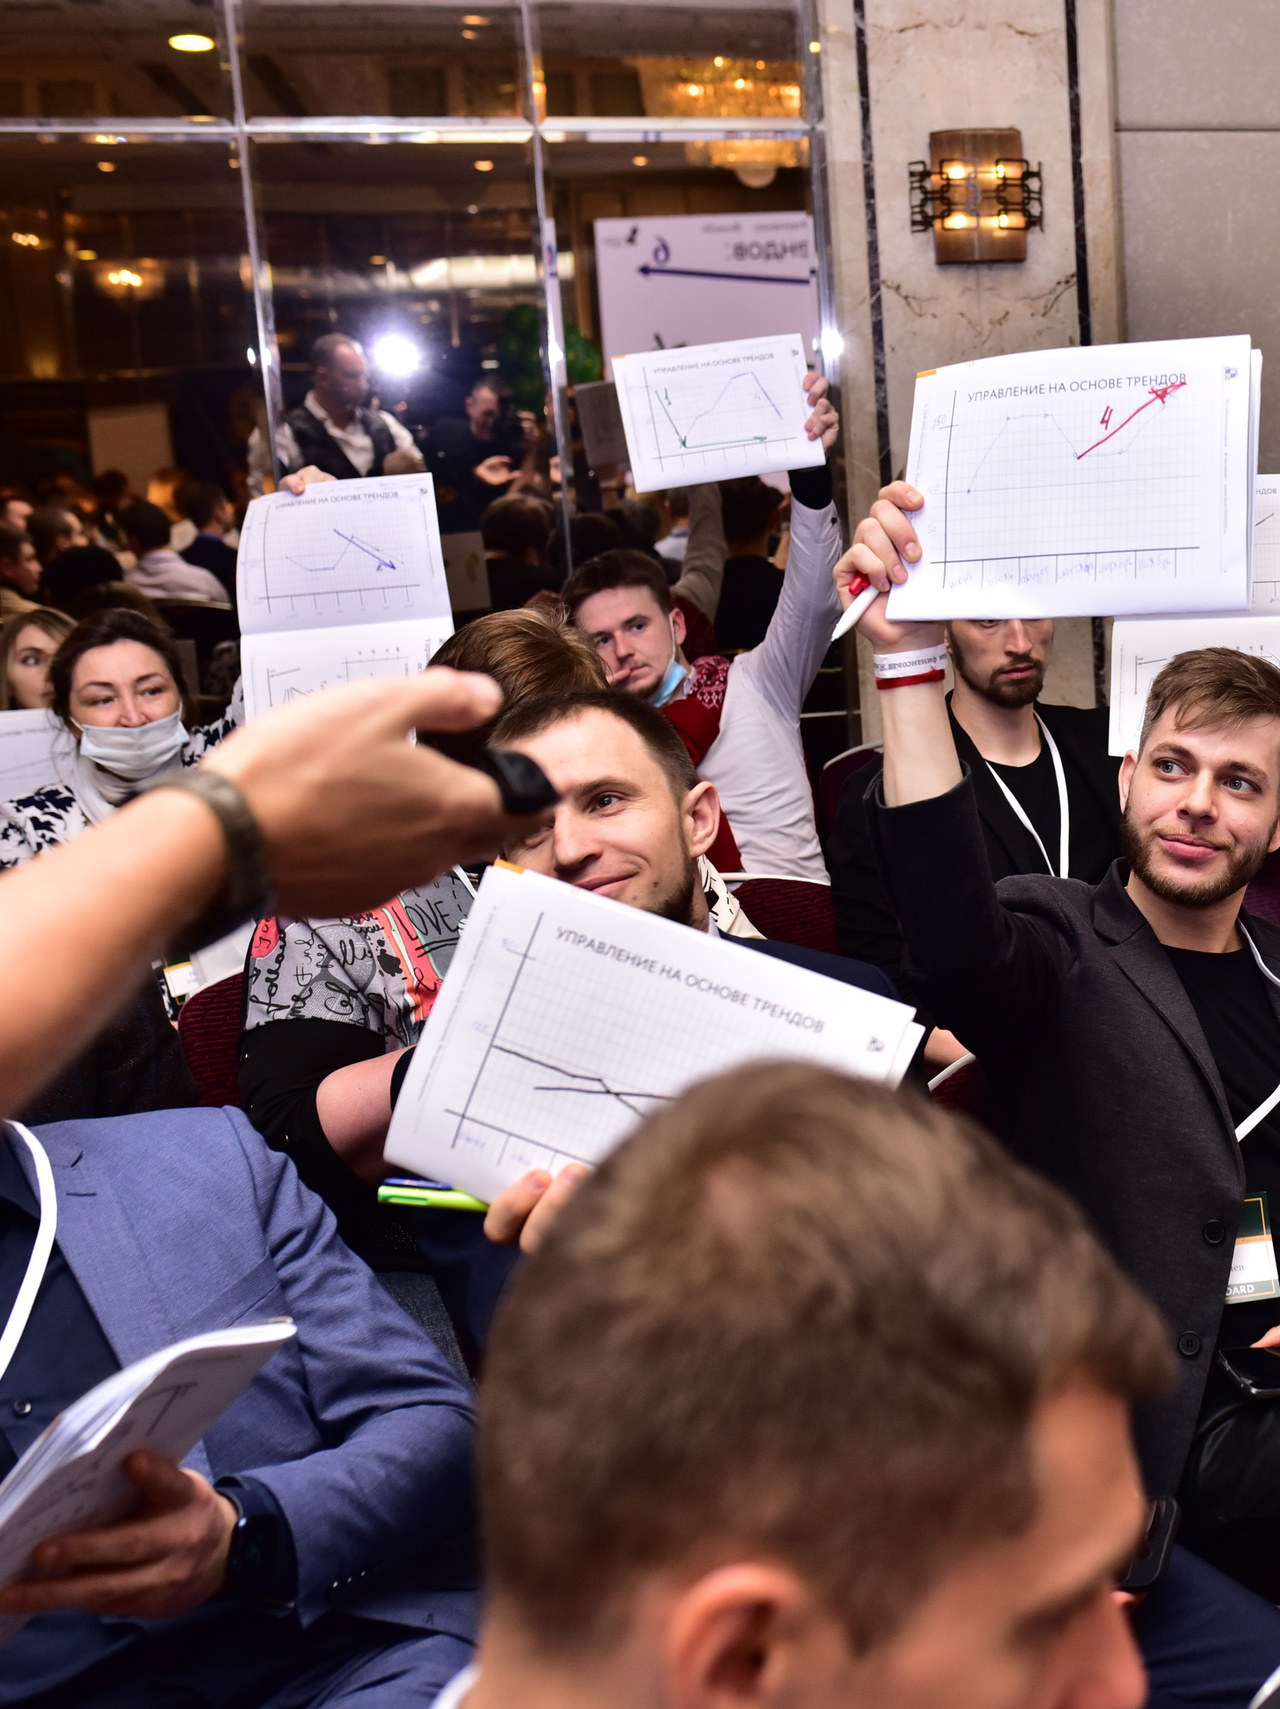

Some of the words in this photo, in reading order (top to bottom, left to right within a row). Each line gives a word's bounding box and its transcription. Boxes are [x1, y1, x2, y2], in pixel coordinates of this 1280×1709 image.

[701, 360, 710, 369] НА
[712, 357, 741, 368] ОСНОВЕ
[743, 352, 775, 363] ТРЕНДОВ
[968, 384, 1046, 403] УПРАВЛЕНИЕ
[1049, 381, 1067, 393] НА
[1070, 378, 1123, 392] ОСНОВЕ
[1126, 373, 1187, 389] ТРЕНДОВ
[1100, 405, 1113, 430] 4
[317, 495, 329, 504] НА
[331, 493, 361, 503] ОСНОВЕ
[364, 491, 399, 501] ТРЕНДОВ
[392, 899, 459, 940] LOVE
[556, 925, 659, 975] УПРАВЛЕНИЕ
[659, 961, 683, 982] НА
[684, 972, 753, 1008] ОСНОВЕ
[753, 996, 825, 1034] ТРЕНДОВ
